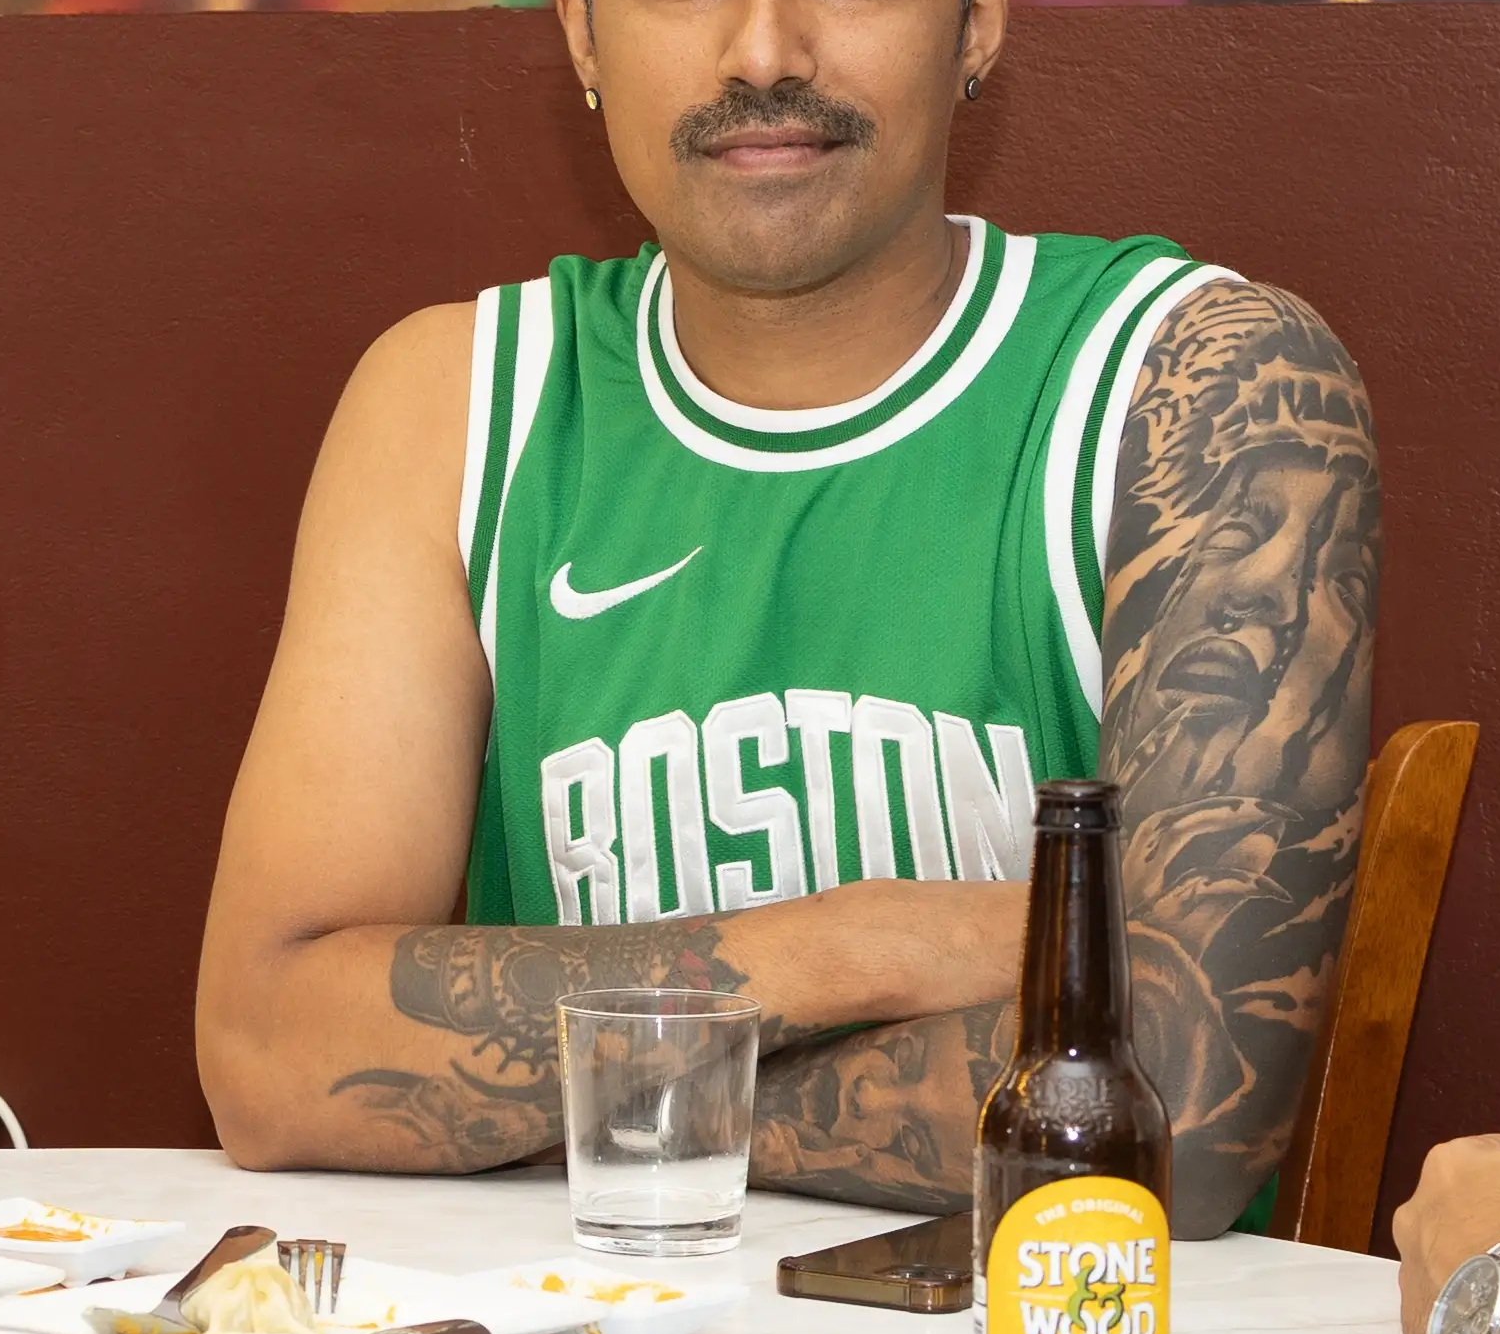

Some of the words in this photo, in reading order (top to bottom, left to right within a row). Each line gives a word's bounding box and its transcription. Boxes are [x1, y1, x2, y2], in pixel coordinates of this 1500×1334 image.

[541, 688, 1037, 926] BOSTON
[1035, 1204, 1067, 1225] THE
[1071, 1198, 1145, 1225] ORIGINAL
[1017, 1238, 1157, 1289] STONE
